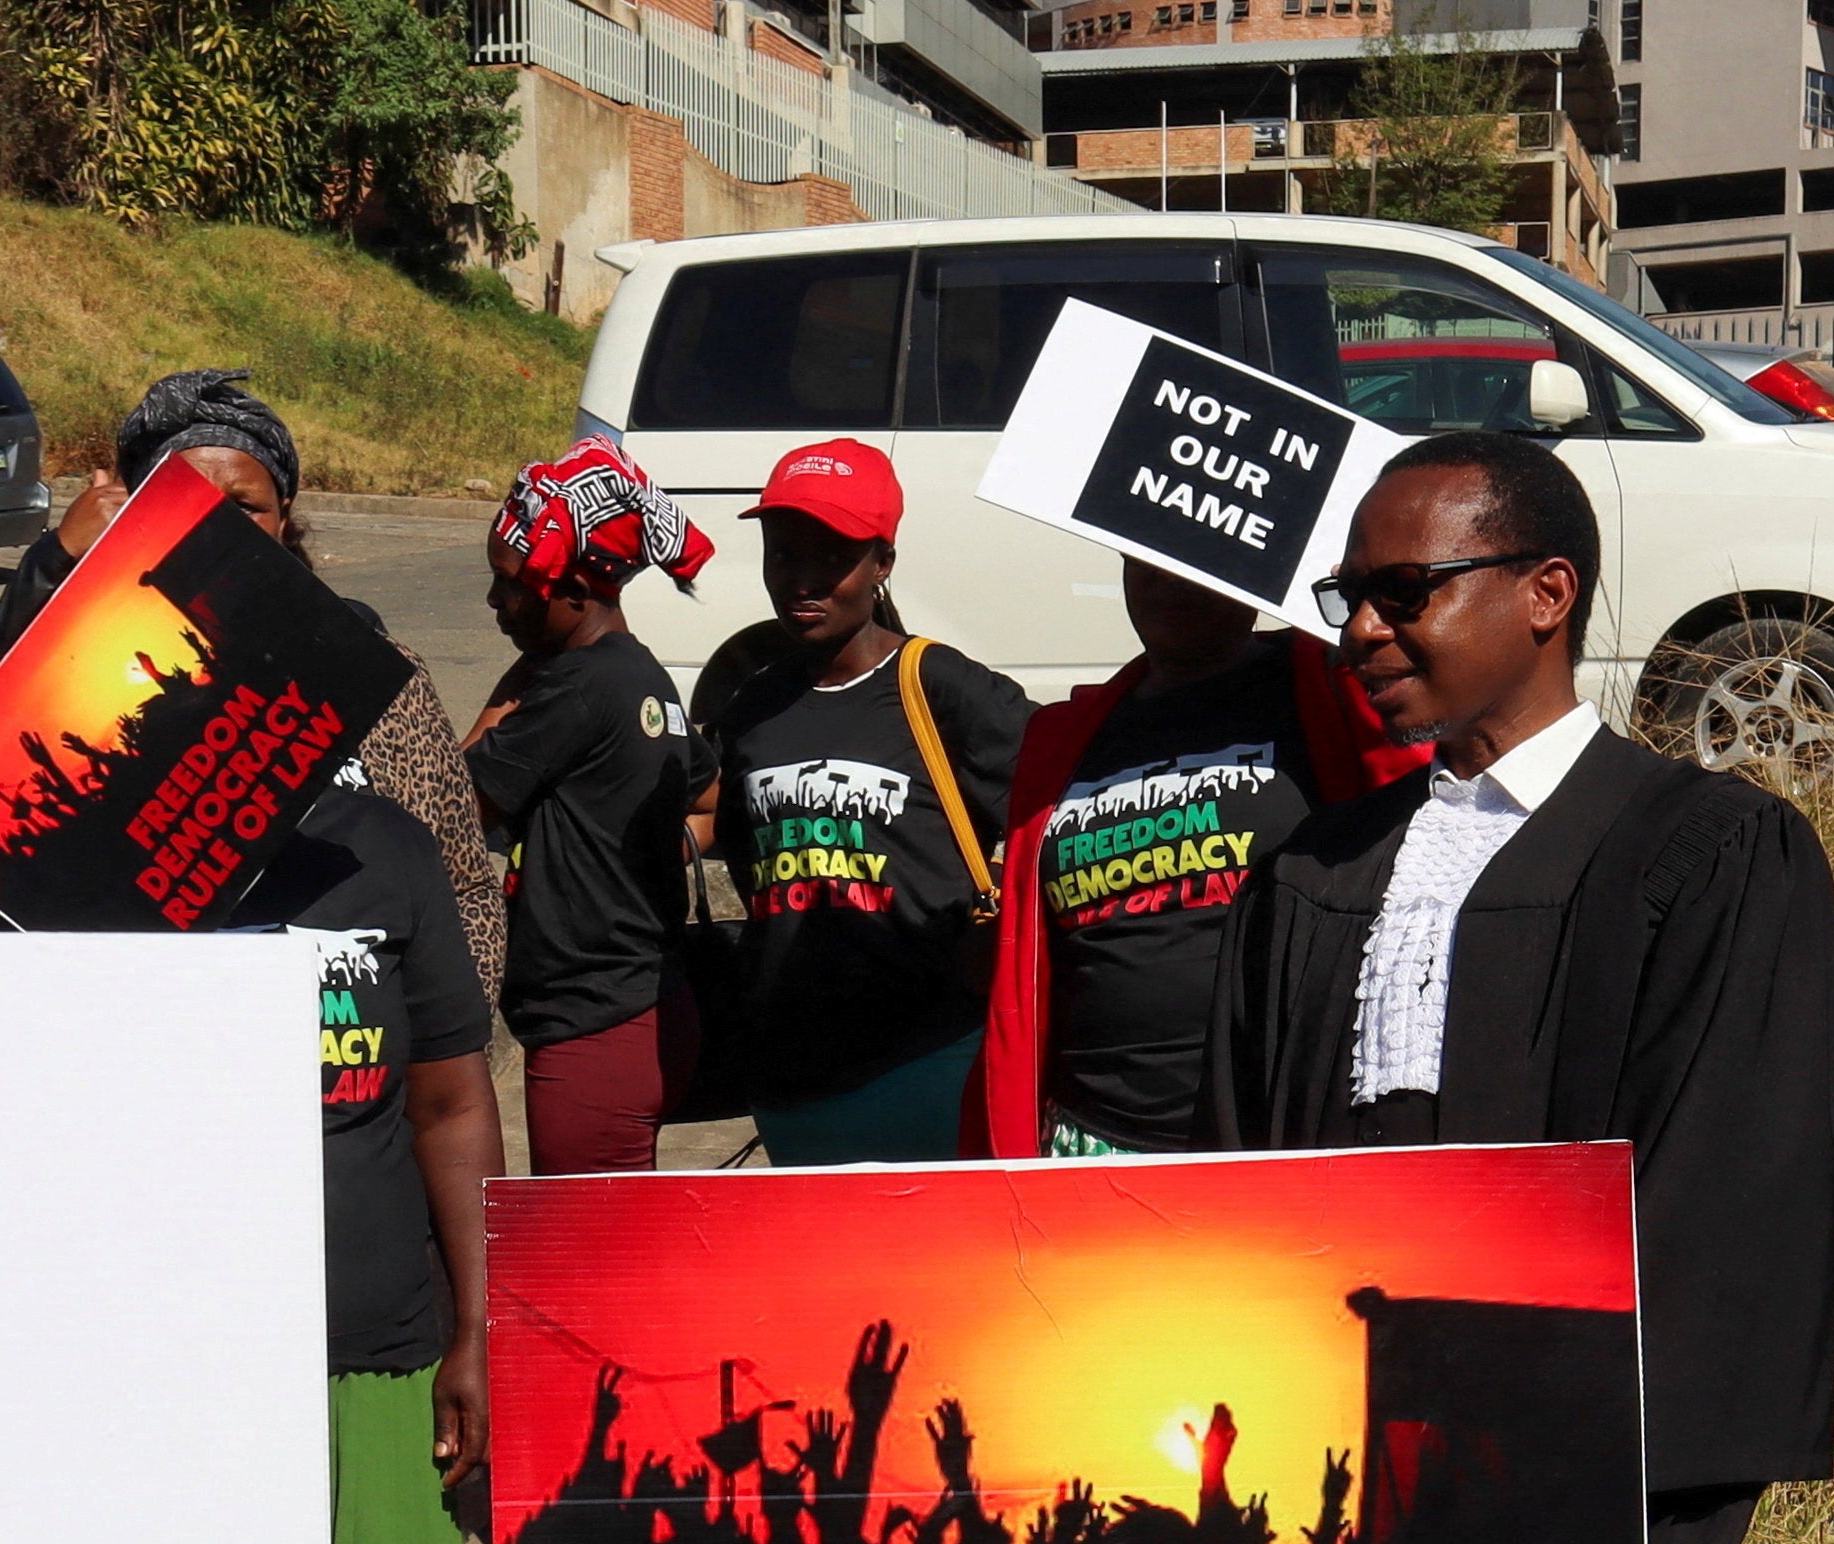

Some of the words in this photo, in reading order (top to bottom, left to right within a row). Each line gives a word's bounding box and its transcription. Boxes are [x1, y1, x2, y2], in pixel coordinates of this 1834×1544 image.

[1153, 379, 1252, 437] NOT
[1269, 427, 1320, 471] IN
[1130, 466, 1275, 550] NAME
[1170, 435, 1271, 499] OUR
[125, 684, 266, 850] FREEDOM
[135, 680, 310, 901] DEMOCRACY
[161, 838, 243, 931] RULE
[233, 784, 279, 840] OF
[271, 702, 344, 790] LAW
[1058, 800, 1221, 872] FREEDOM
[1044, 831, 1255, 913] DEMOCRACY
[1125, 883, 1174, 914] OF
[322, 1064, 388, 1103] AW
